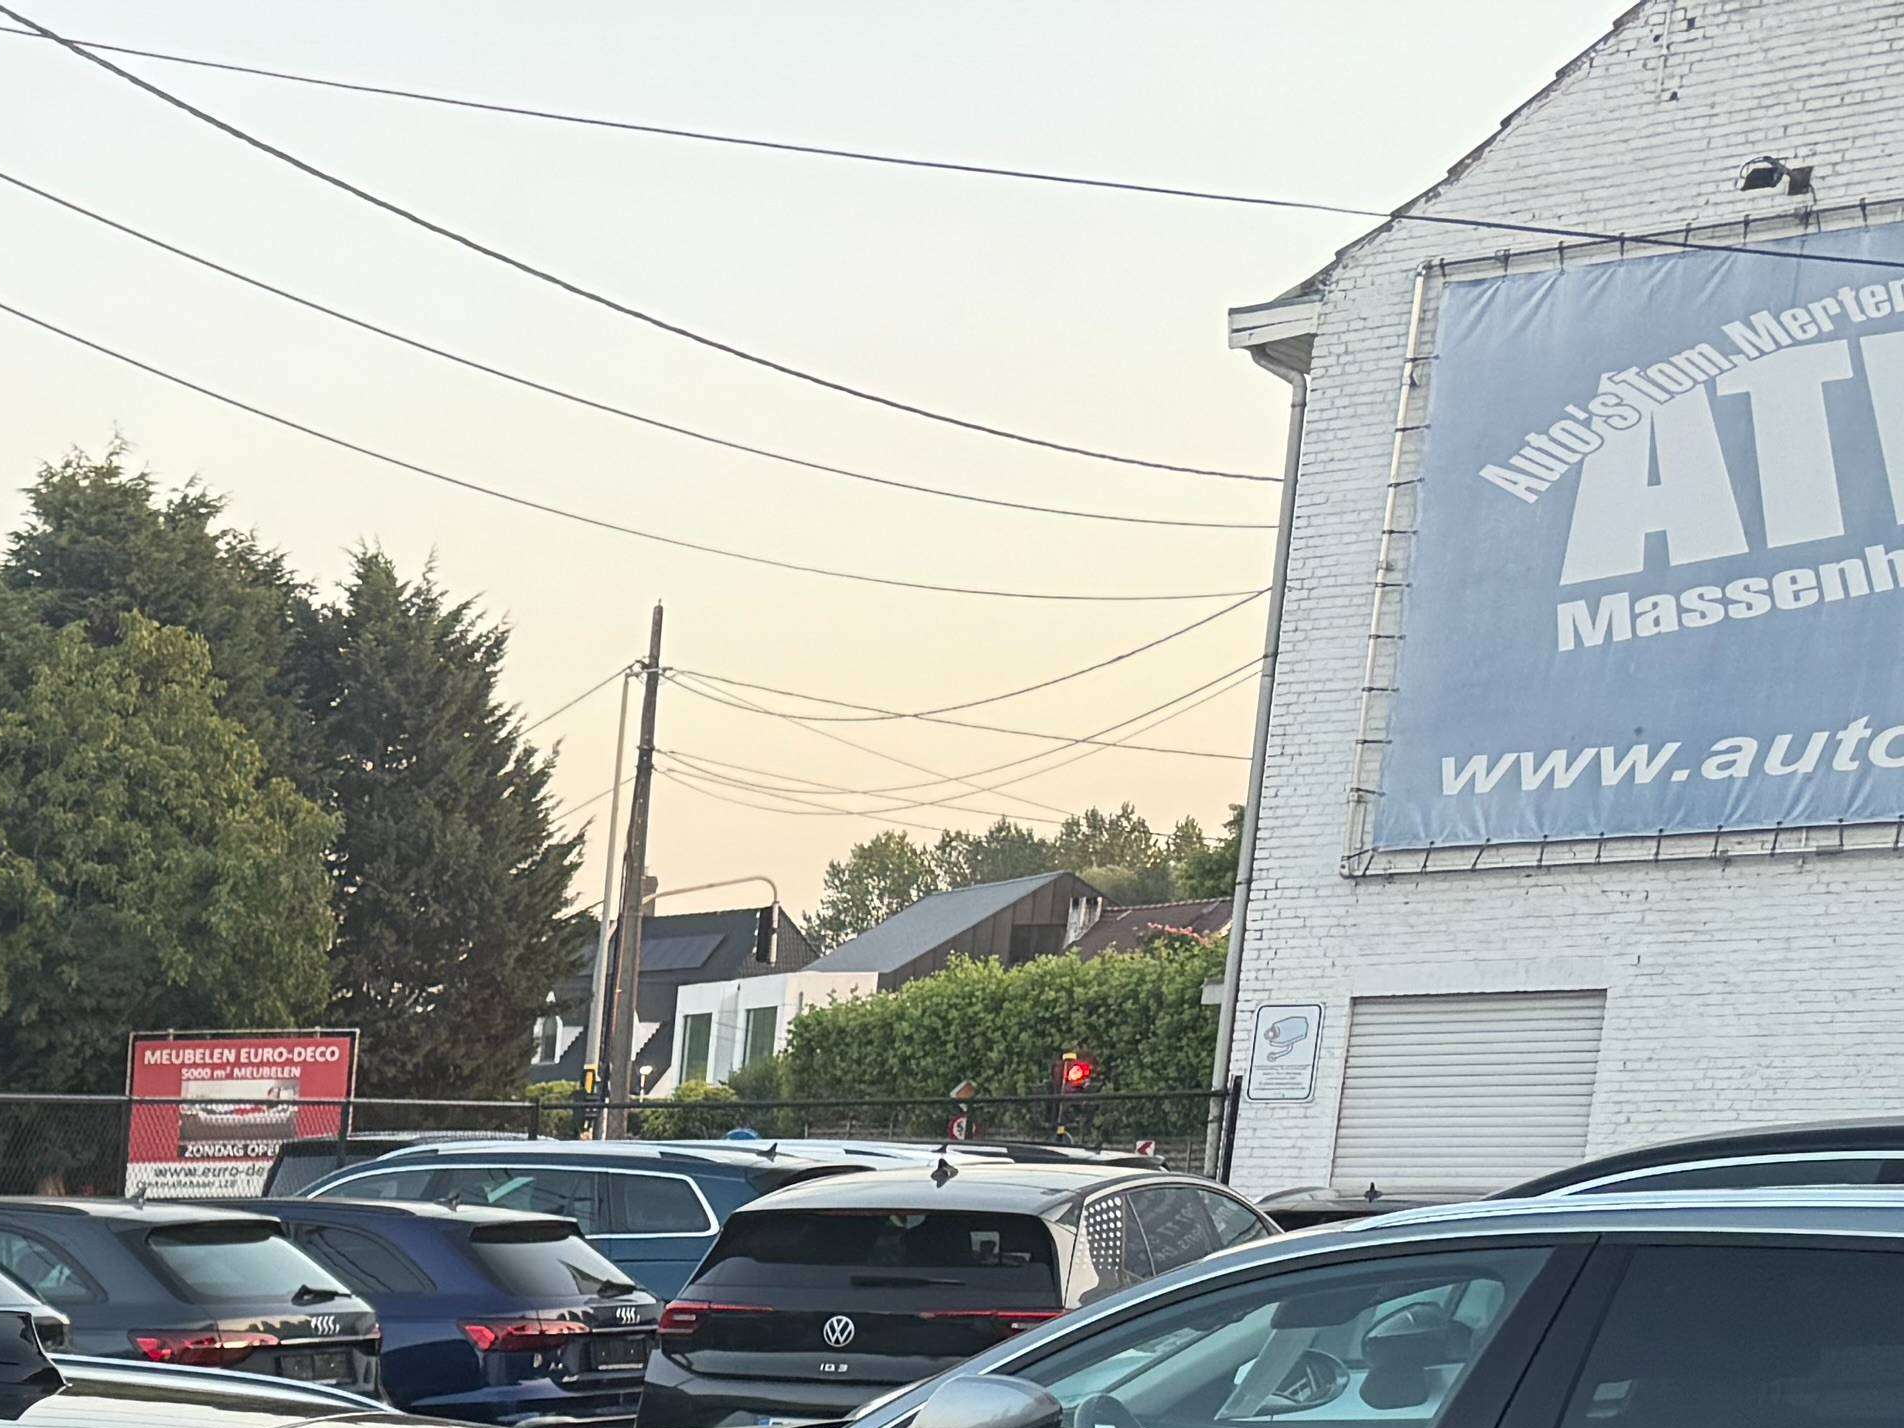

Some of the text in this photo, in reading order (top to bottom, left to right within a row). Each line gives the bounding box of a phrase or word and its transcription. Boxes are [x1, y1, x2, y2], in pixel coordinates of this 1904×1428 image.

[1477, 391, 1642, 504] Auto's
[1611, 341, 1737, 405] Tom
[143, 1045, 340, 1065] MEUBELEN EURO-DECO
[181, 1067, 211, 1080] 5000
[233, 1066, 301, 1079] MEUBELEN
[184, 1144, 244, 1158] ZONDAG
